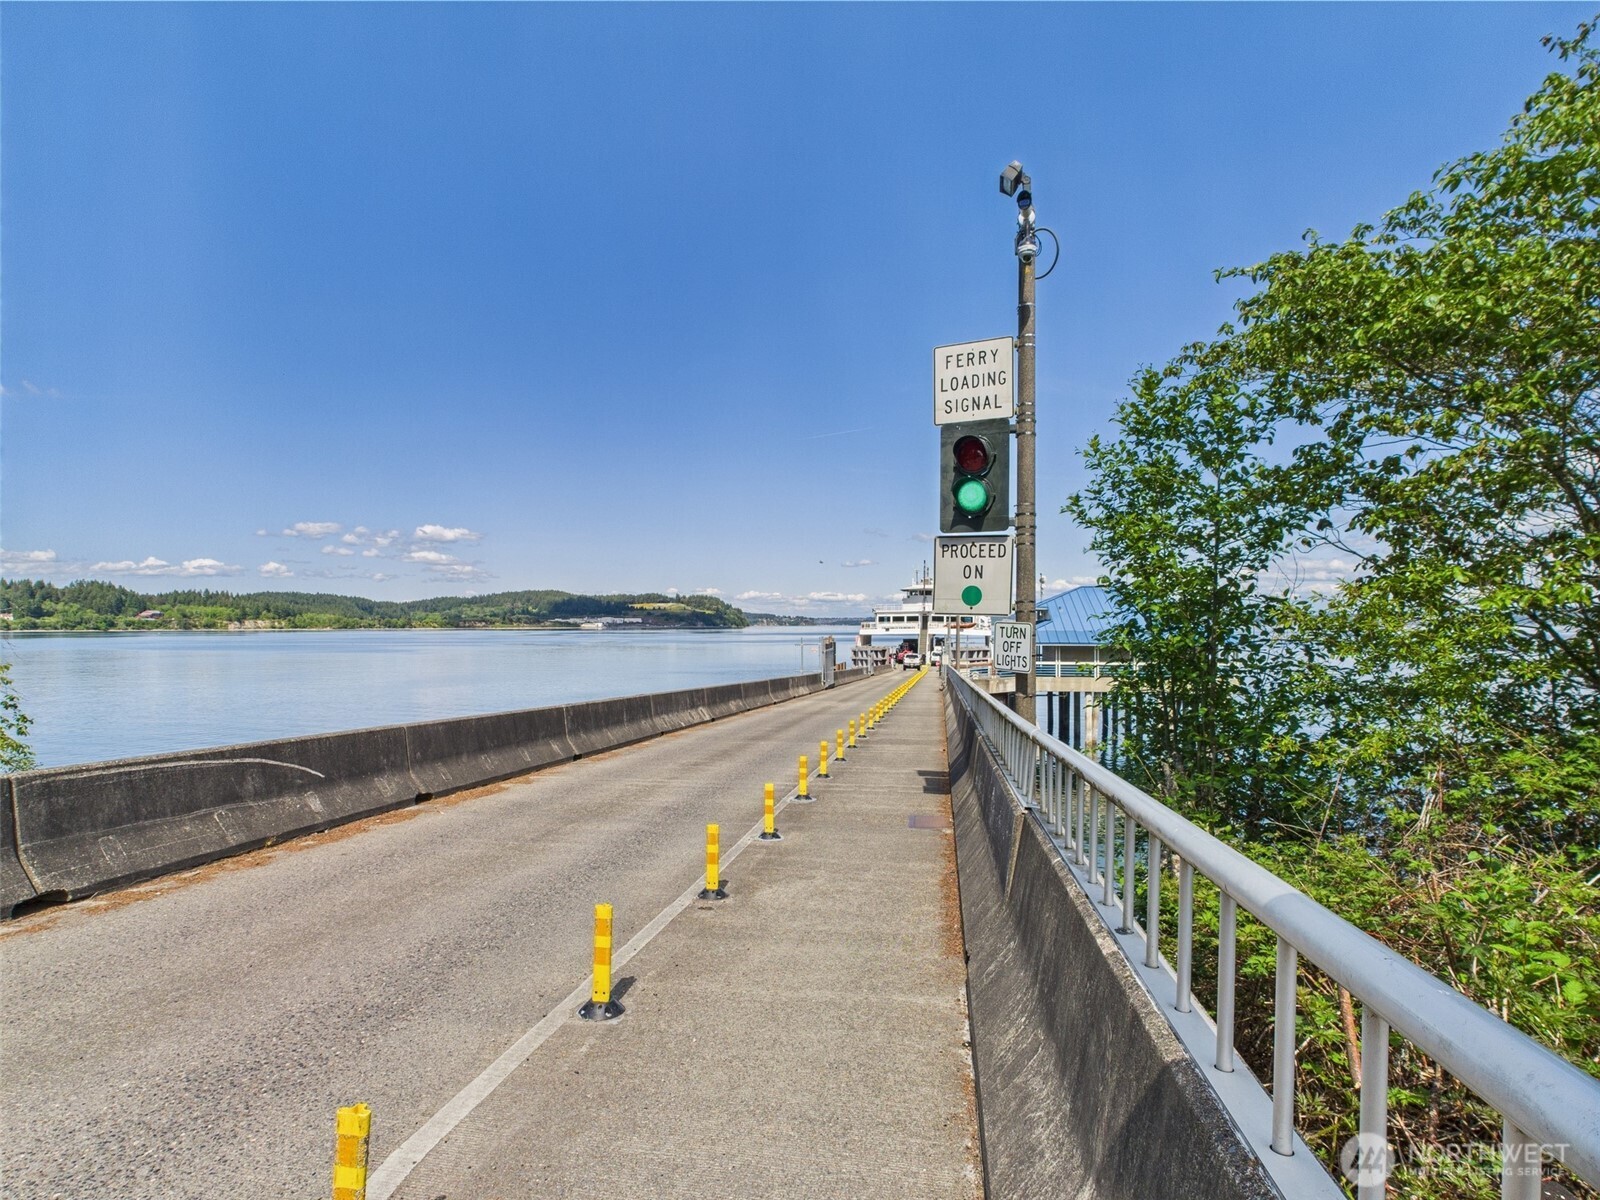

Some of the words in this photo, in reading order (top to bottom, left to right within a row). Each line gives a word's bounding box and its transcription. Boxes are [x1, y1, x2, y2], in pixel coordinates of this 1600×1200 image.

[945, 348, 999, 370] FERRY
[940, 370, 1007, 393] LOADING
[944, 394, 1003, 415] SIGNAL
[941, 543, 1007, 559] PROCEED
[962, 564, 984, 580] ON
[1000, 626, 1027, 640] TURN
[1002, 640, 1022, 653] OFF
[996, 654, 1028, 668] LIGHTS
